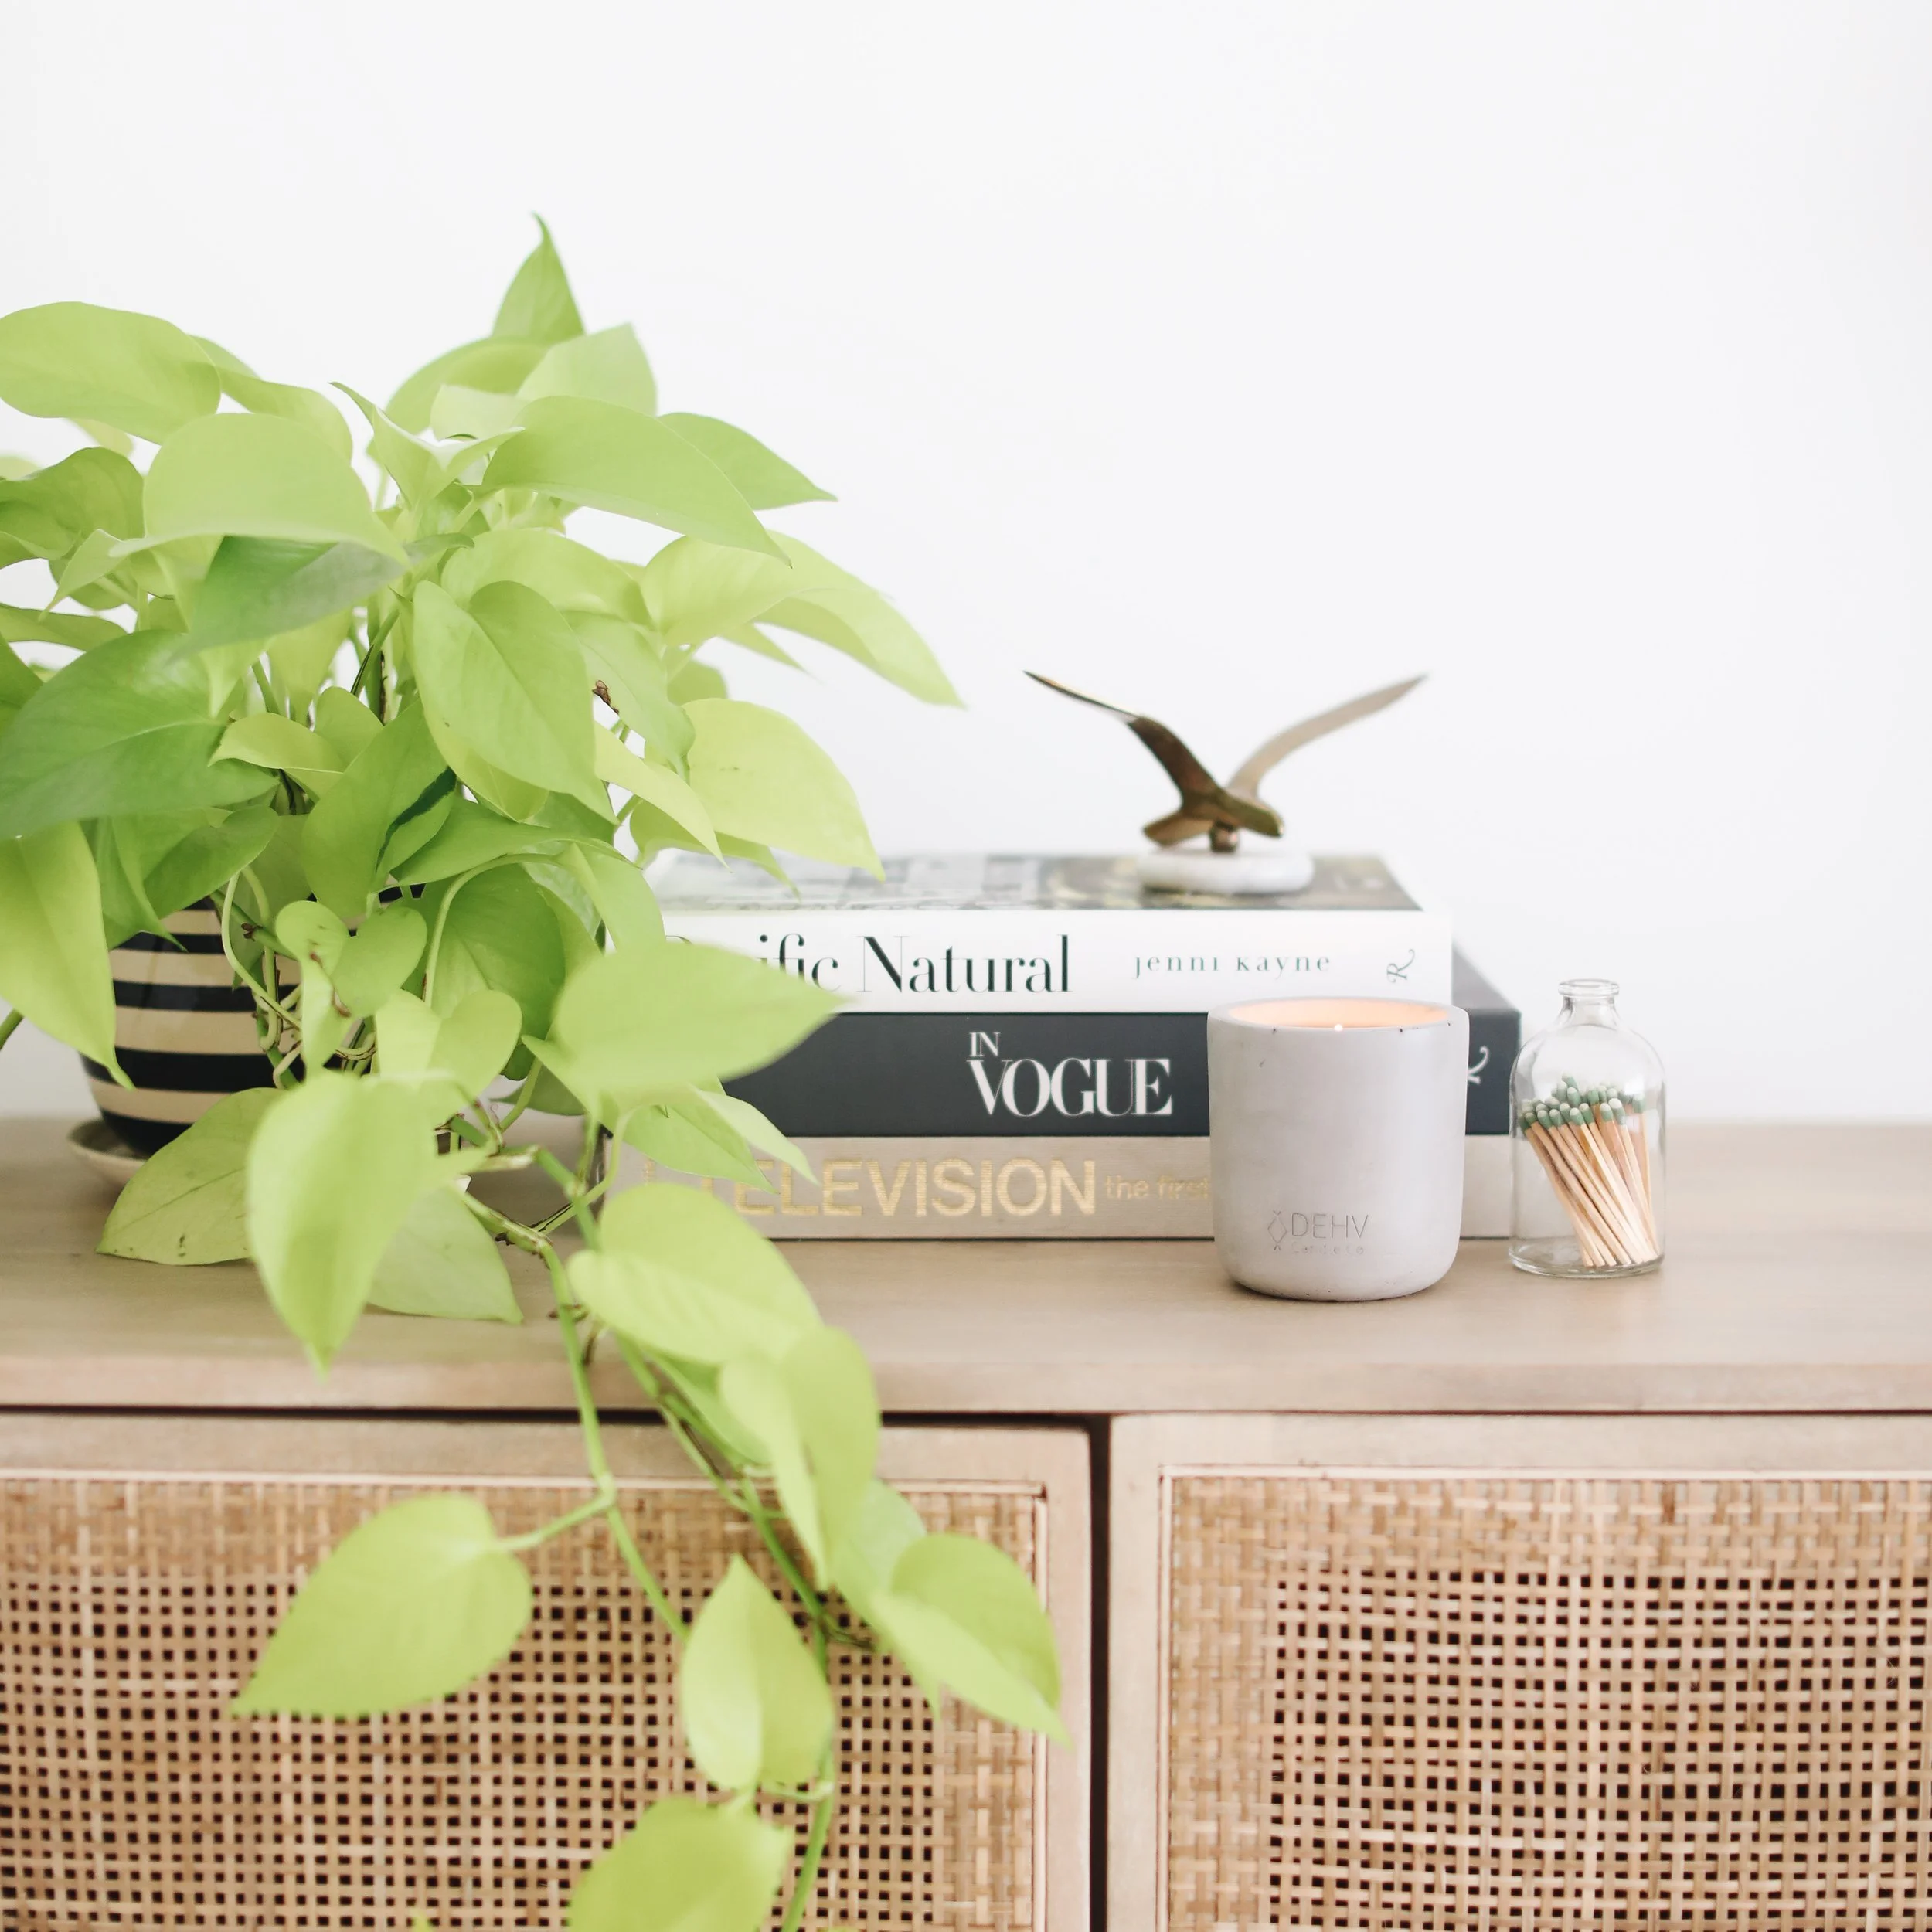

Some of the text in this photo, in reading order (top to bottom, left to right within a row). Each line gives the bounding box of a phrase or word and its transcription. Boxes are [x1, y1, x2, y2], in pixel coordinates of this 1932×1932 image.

[856, 934, 1073, 993] Natural
[1131, 956, 1331, 980] jenni kayne
[969, 1032, 1001, 1057] IN
[966, 1057, 1172, 1117] VOGUE
[1105, 1175, 1149, 1199] the
[1291, 1213, 1369, 1239] DEHV
